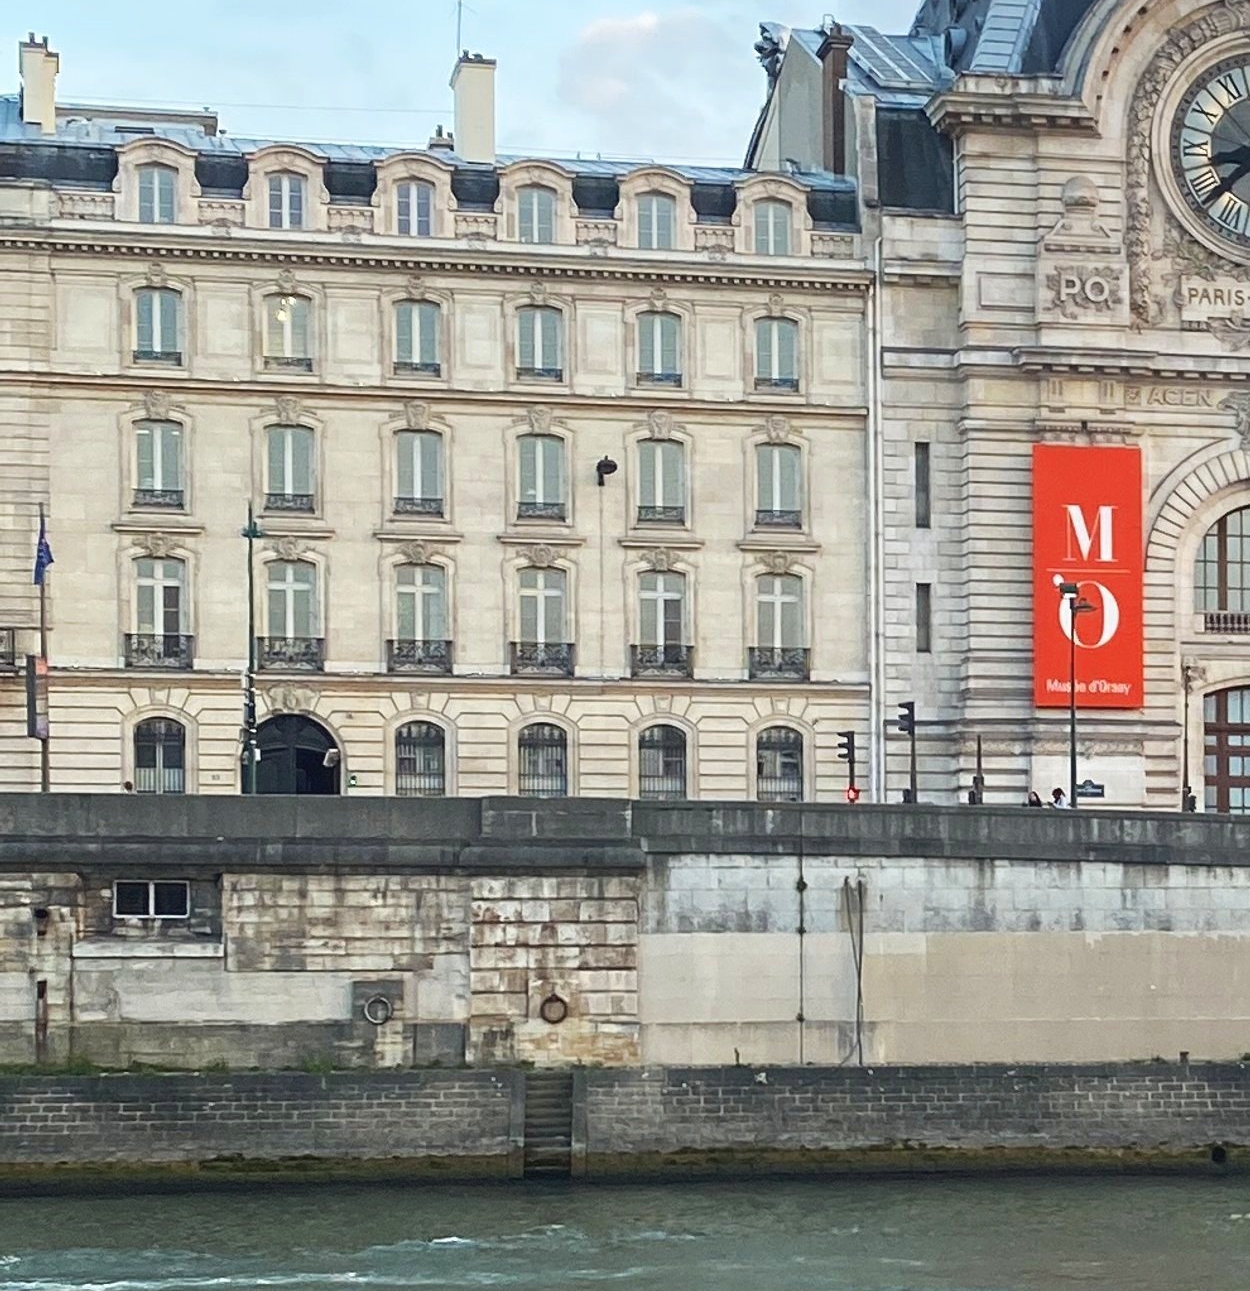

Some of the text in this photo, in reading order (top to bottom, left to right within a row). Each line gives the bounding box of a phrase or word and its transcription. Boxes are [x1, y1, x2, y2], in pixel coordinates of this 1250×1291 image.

[1215, 73, 1243, 105] XI
[1190, 100, 1219, 126] X
[1183, 138, 1210, 159] IX
[1190, 168, 1220, 205] III
[1218, 198, 1240, 231] VII
[1060, 275, 1110, 303] PO
[1061, 504, 1119, 563] M
